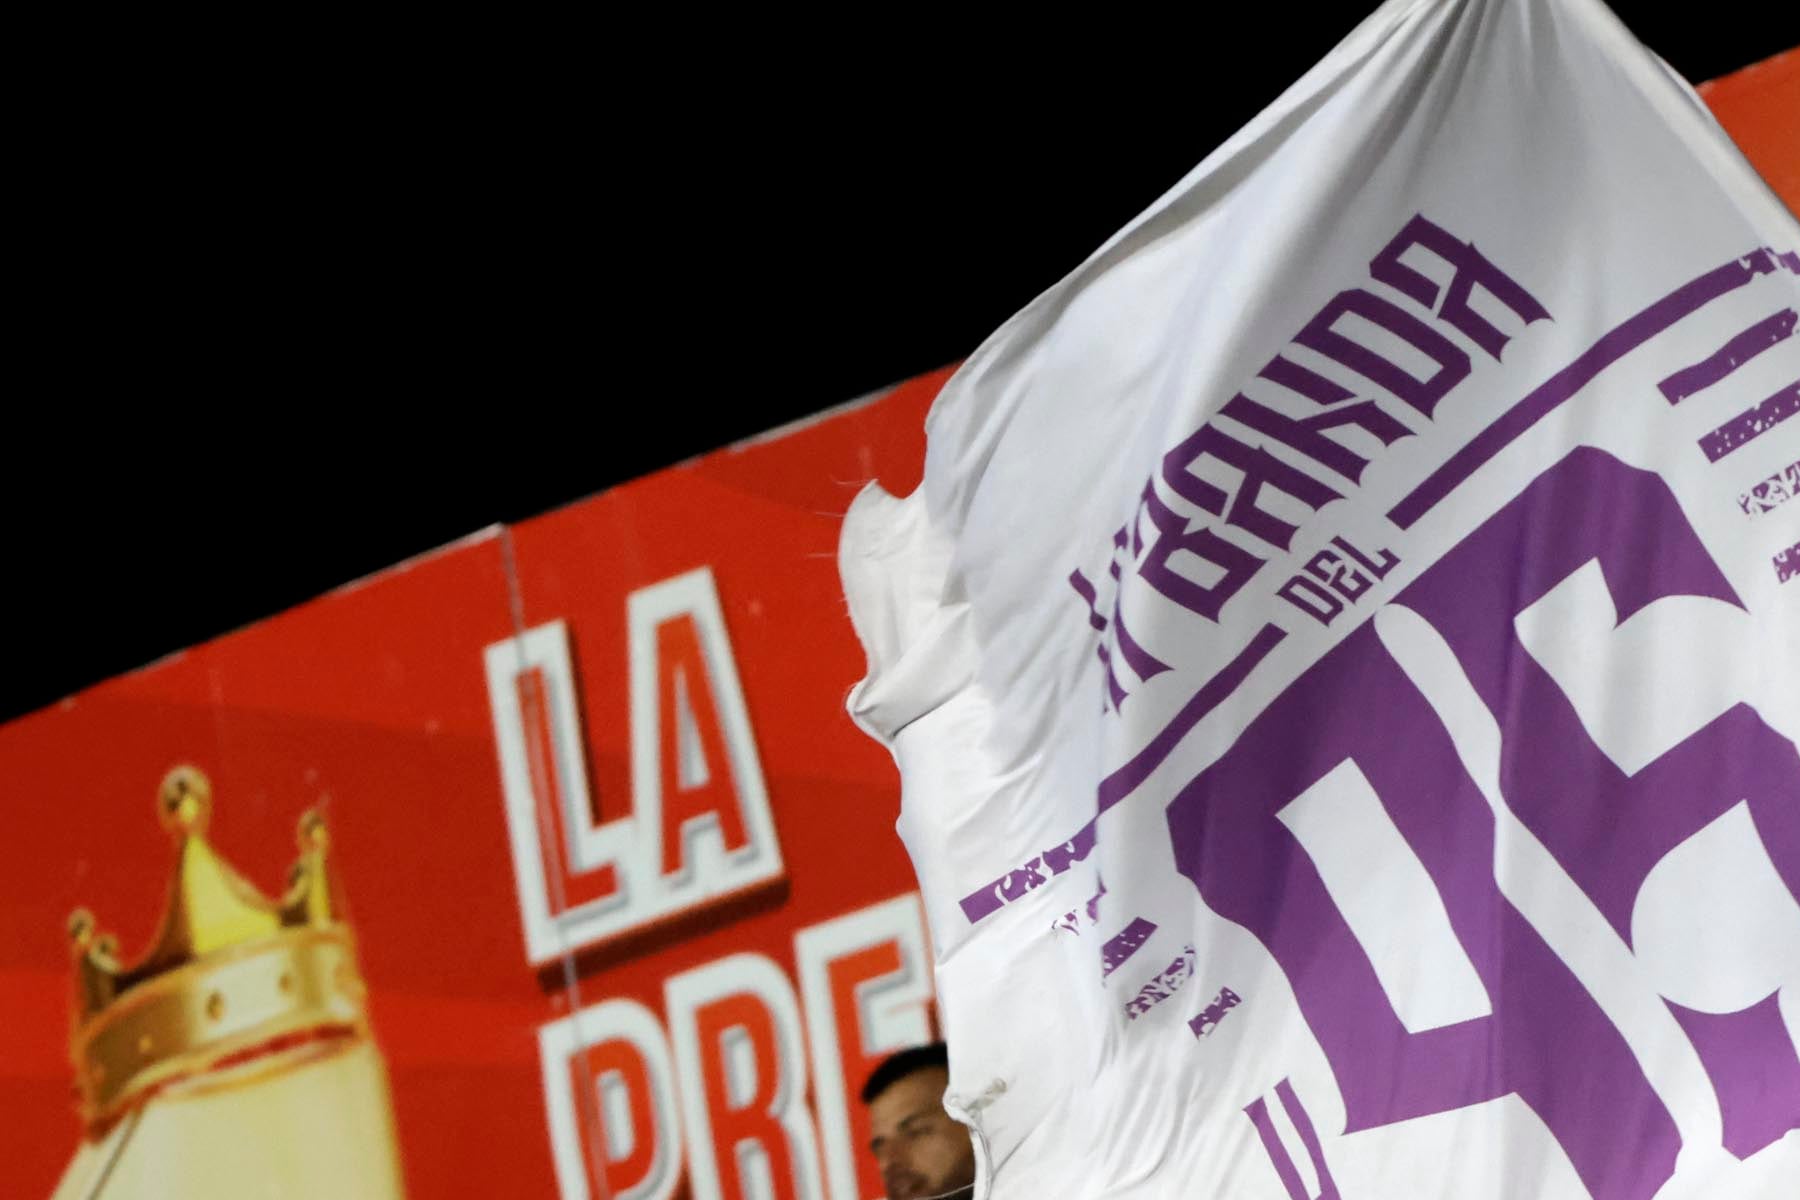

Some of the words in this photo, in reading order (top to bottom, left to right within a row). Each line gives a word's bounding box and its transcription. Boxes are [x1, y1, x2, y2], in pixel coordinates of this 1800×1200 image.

[1132, 212, 1555, 624] BANDA
[1274, 535, 1402, 628] DEL
[484, 565, 784, 970] LA
